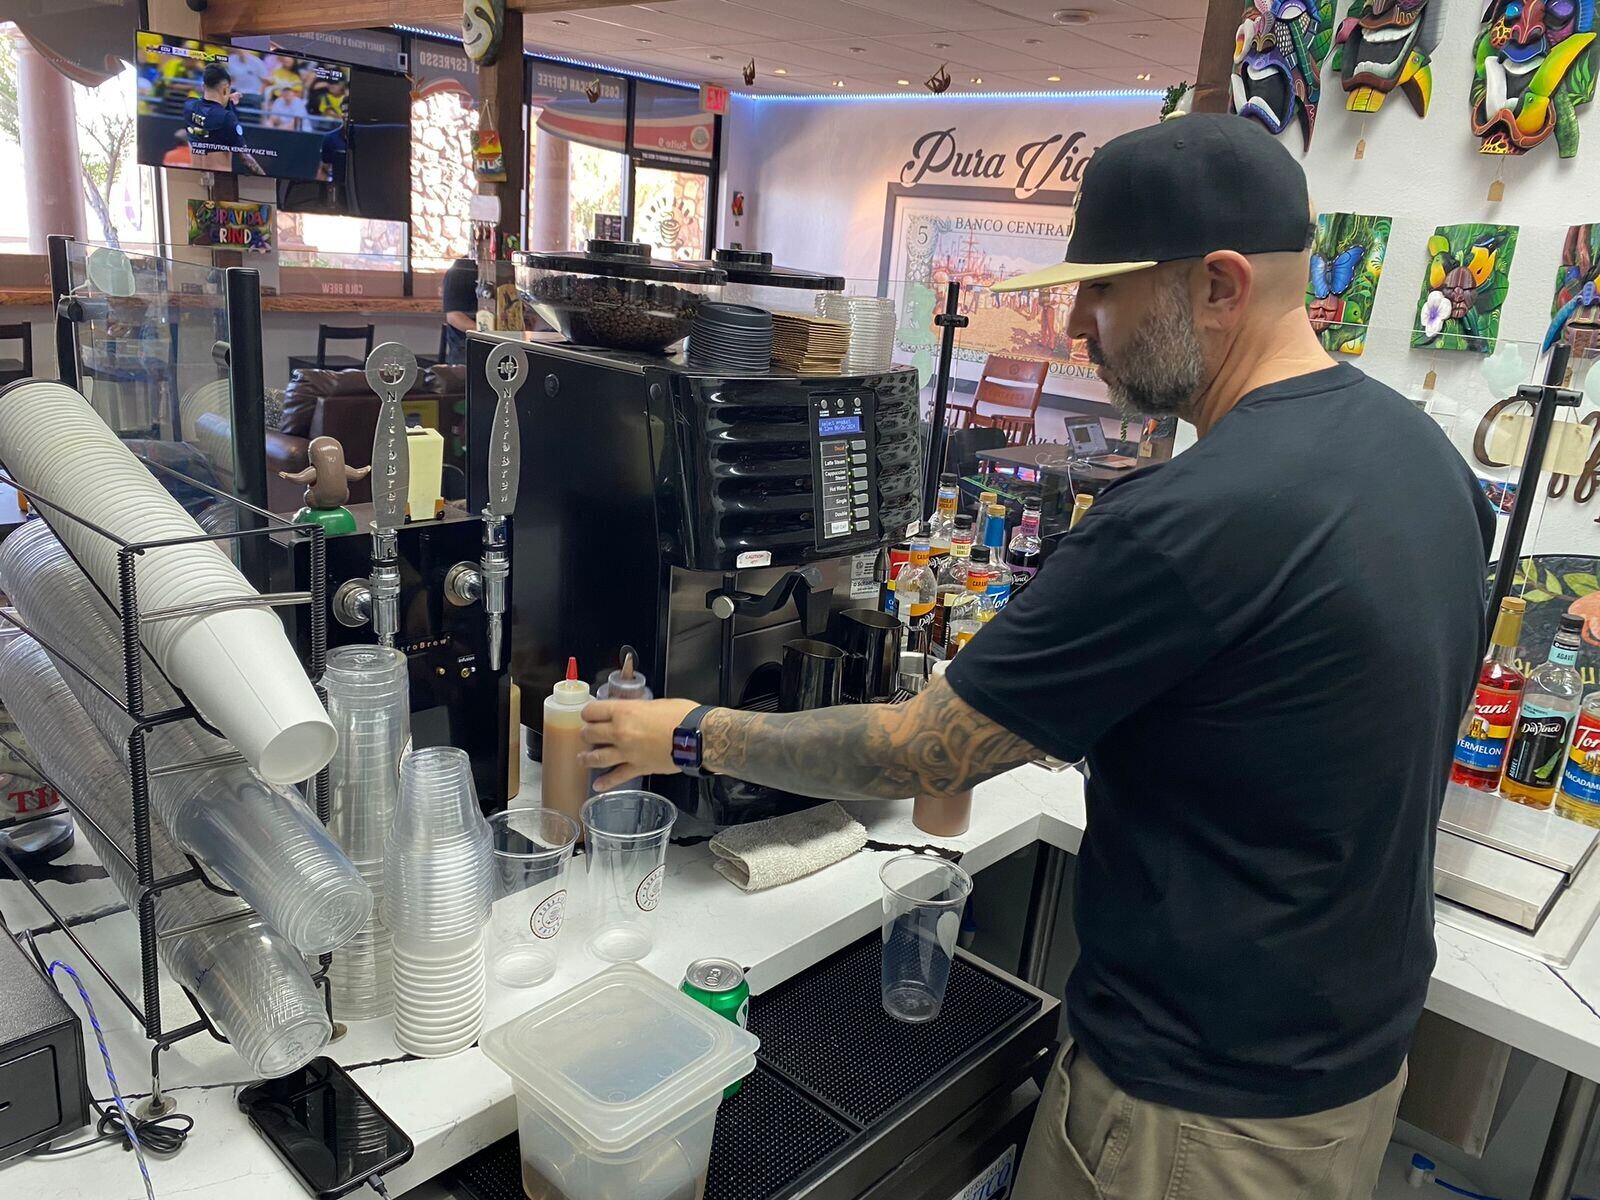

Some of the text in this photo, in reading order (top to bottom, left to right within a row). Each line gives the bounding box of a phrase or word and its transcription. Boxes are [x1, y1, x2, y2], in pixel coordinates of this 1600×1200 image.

[900, 127, 1100, 199] Pura Vid
[955, 217, 1002, 232] BANCO
[917, 226, 928, 245] 5
[1049, 361, 1098, 379] OLONE
[1556, 652, 1575, 661] AGAVE
[1475, 700, 1512, 715] rani
[1456, 738, 1503, 756] TERMELON
